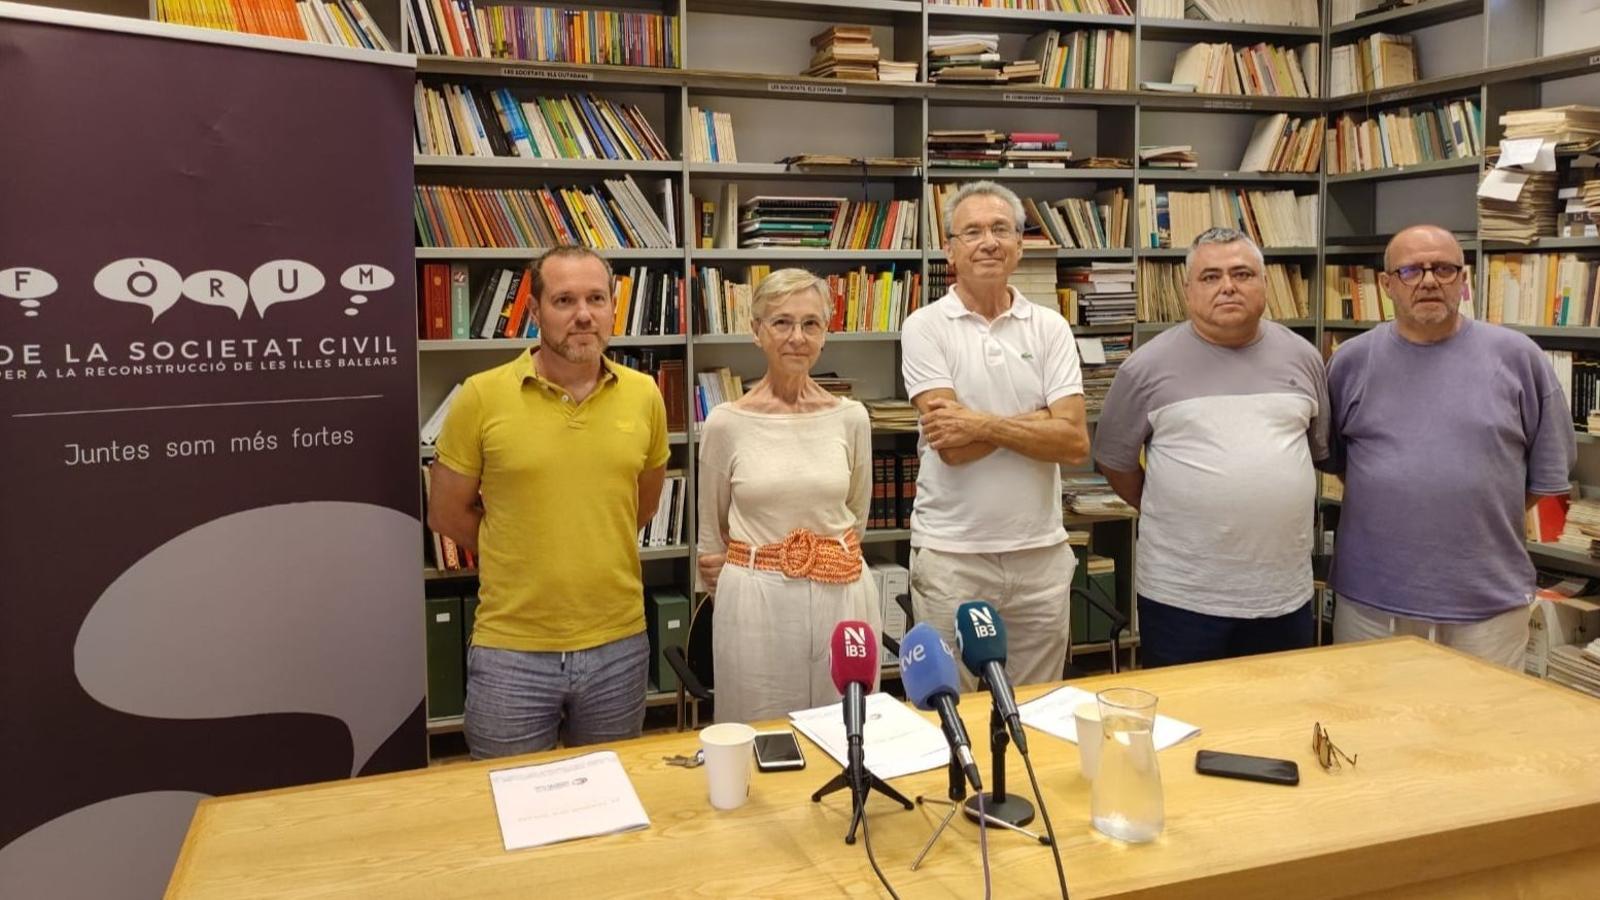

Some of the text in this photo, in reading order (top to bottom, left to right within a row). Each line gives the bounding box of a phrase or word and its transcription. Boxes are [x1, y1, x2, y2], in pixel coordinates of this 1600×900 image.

[0, 336, 397, 365] DE LA SOCIETAT CIVIL
[0, 356, 398, 380] ER A LA RECONSTRUCCIÓ DE LES ILLES BALEARS
[65, 426, 354, 466] Juntes som més fortes
